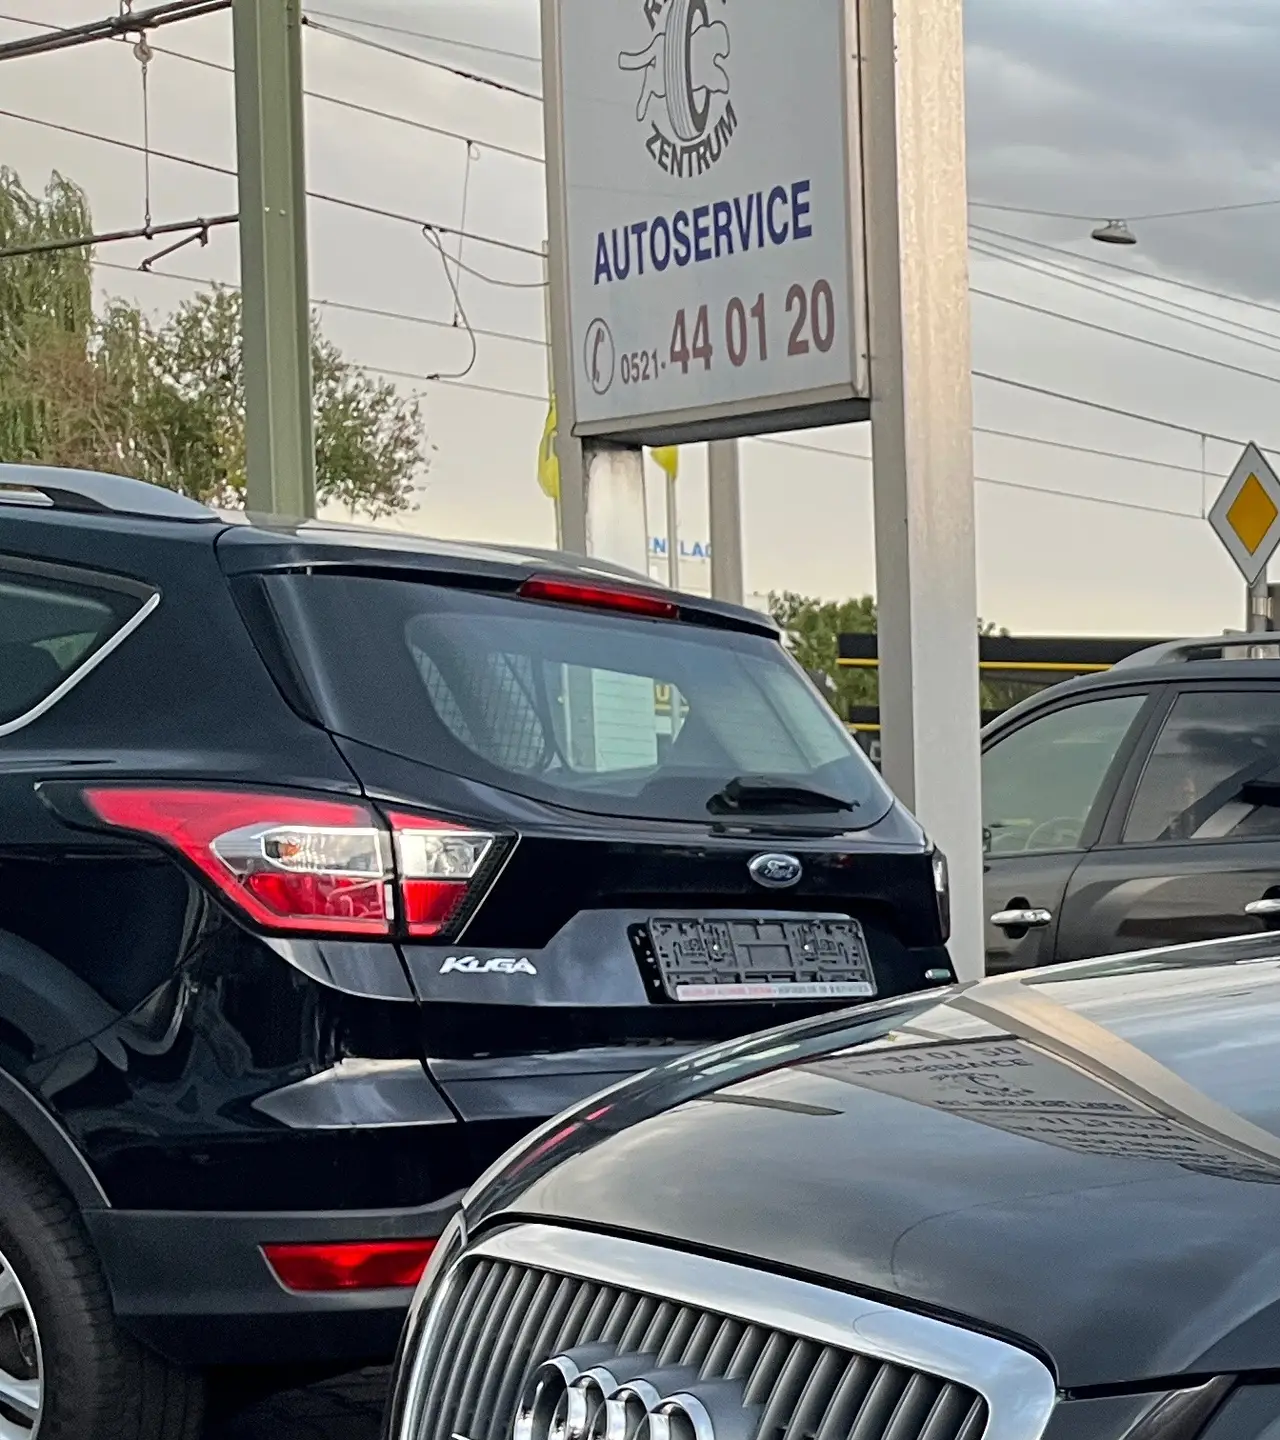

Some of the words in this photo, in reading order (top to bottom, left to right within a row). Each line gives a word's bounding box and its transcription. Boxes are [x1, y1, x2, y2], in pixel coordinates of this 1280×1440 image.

[645, 99, 737, 178] ZENTRUM
[594, 180, 812, 285] AUTOSERVICE
[726, 292, 767, 367] 01
[785, 279, 835, 356] 20
[439, 956, 537, 975] KUGA
